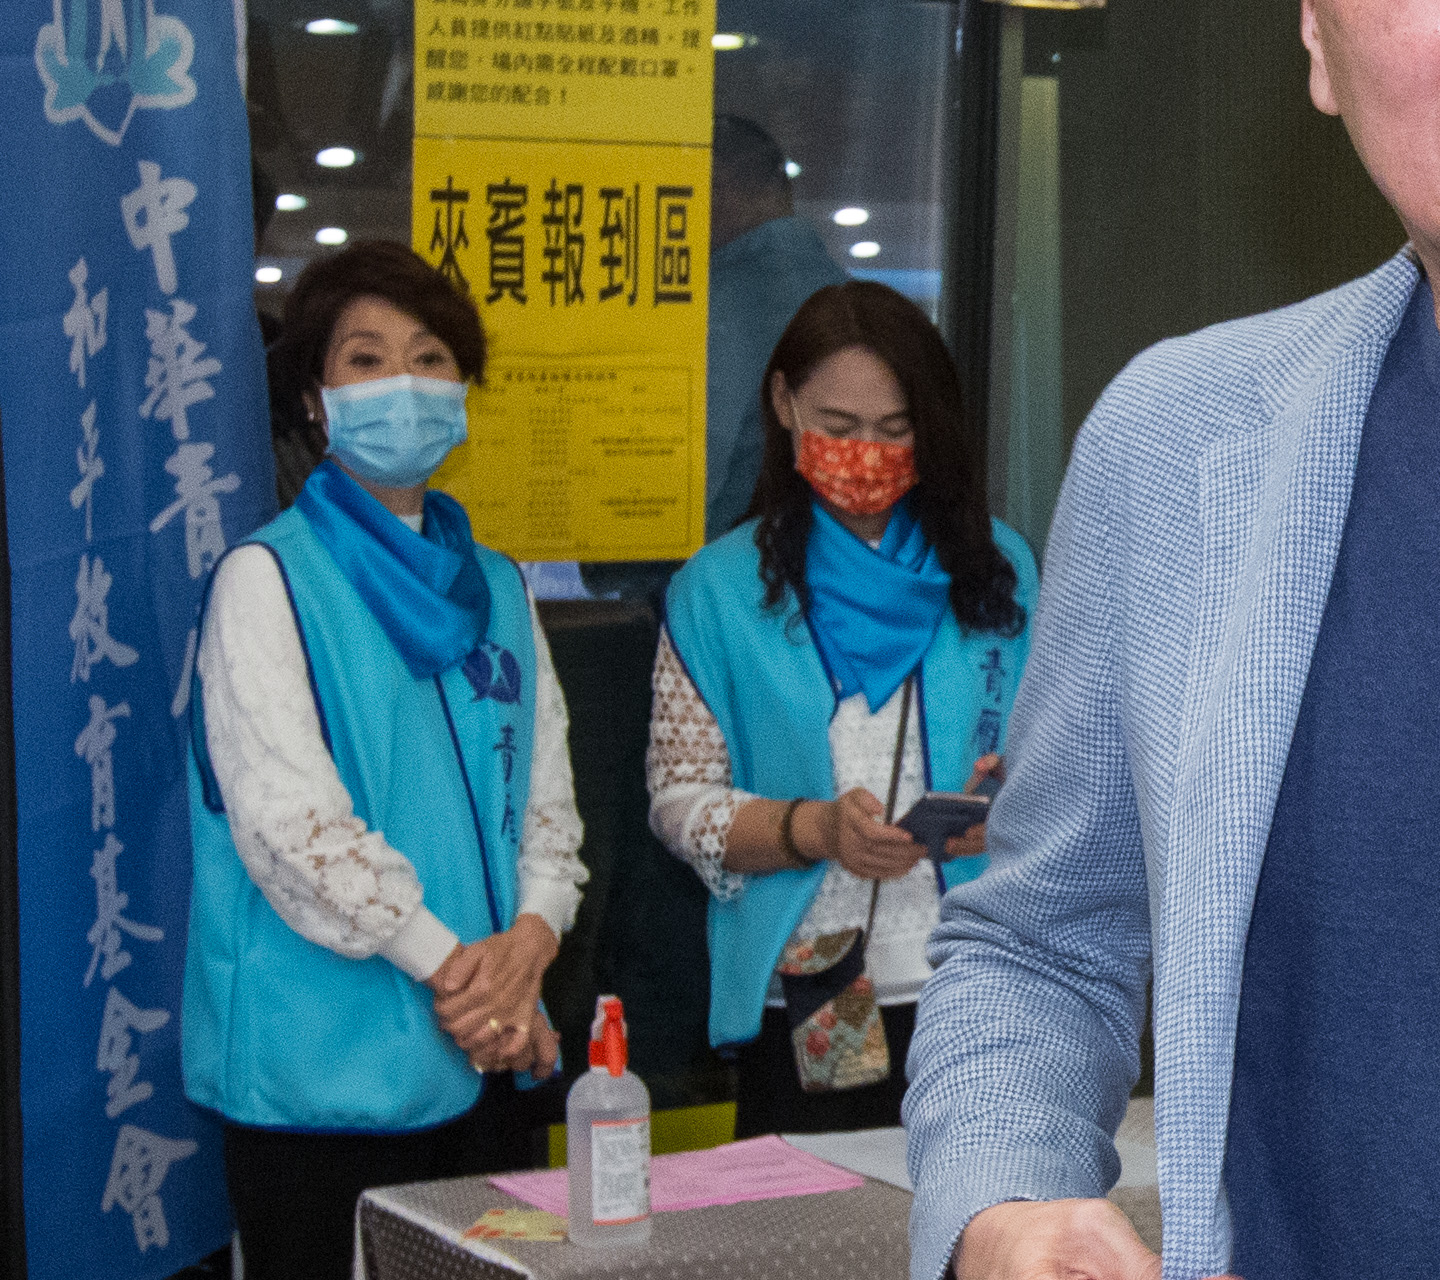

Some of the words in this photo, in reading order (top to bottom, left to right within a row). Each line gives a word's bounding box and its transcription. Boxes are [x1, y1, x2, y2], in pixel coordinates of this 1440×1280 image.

[428, 174, 694, 308] 來賓報到區
[120, 160, 242, 718] 中華青
